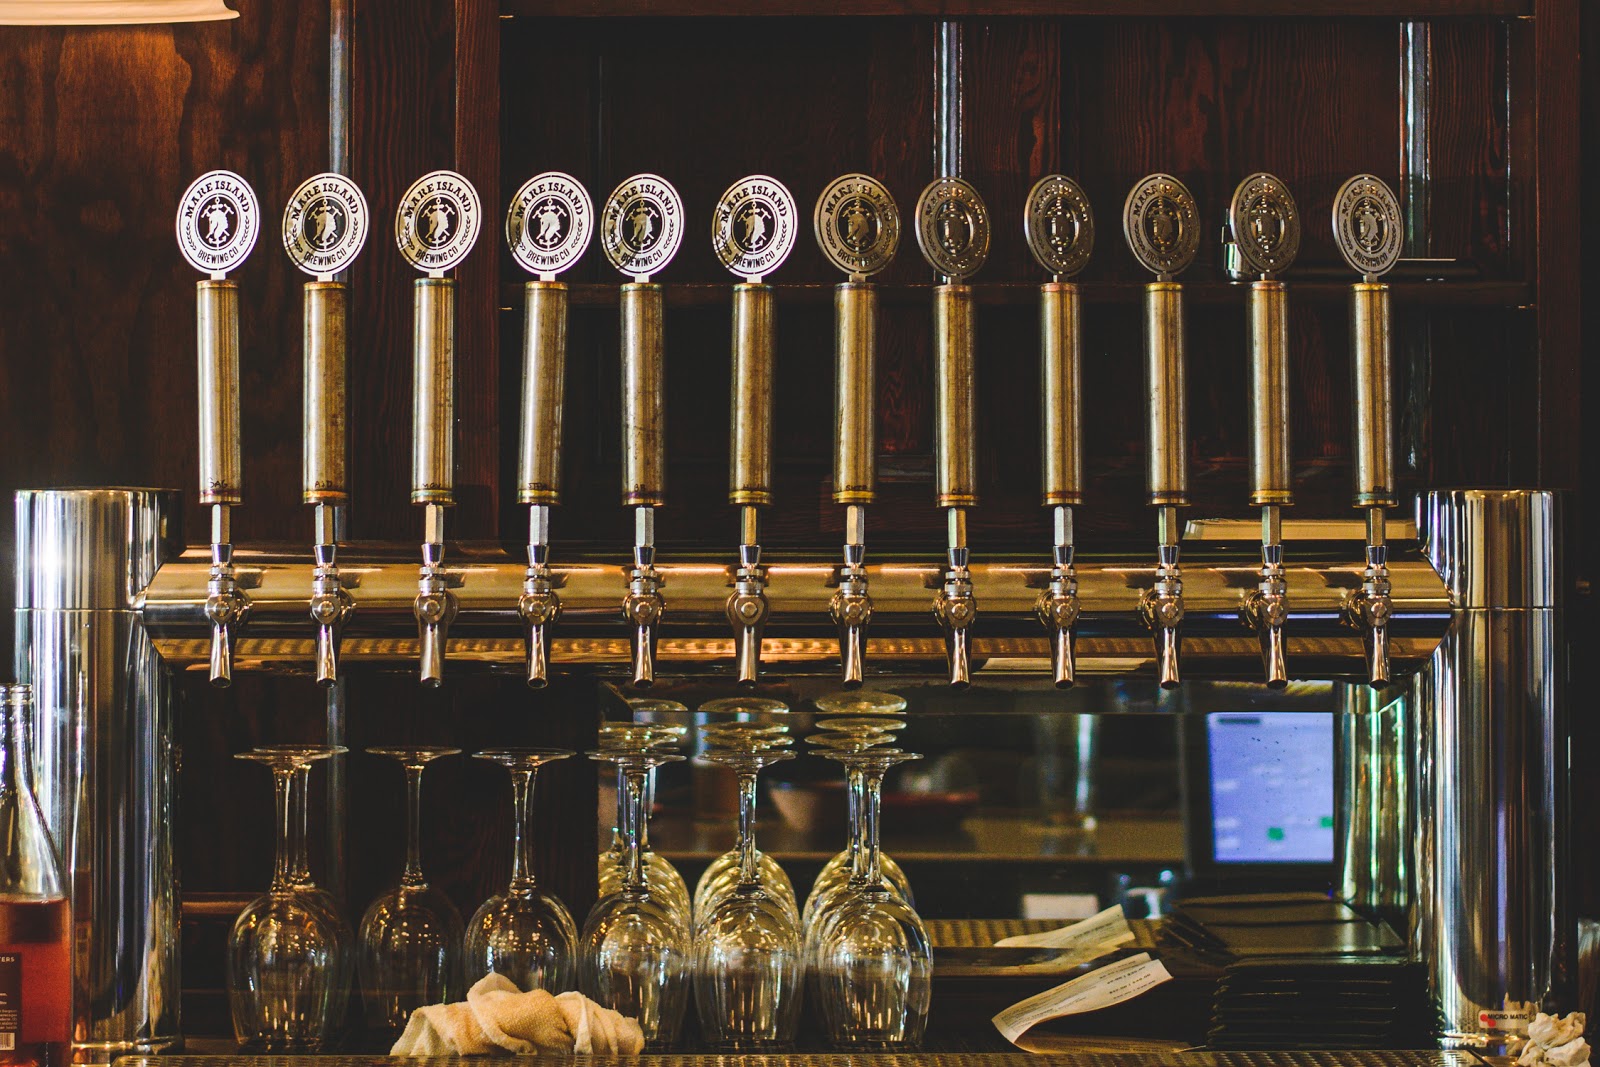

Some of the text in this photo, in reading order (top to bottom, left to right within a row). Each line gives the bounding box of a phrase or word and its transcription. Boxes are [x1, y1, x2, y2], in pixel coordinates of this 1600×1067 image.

[187, 180, 250, 218] MARE ISLAND
[293, 182, 358, 220] MARE ISLAND
[404, 182, 471, 218] MARE ISLAND
[516, 182, 584, 221] MARE ISLAND
[610, 184, 674, 221] MARE ISLAND
[722, 185, 787, 223] MARE ISLAND
[825, 184, 854, 216] MARE
[197, 248, 229, 264] BREWING
[304, 251, 336, 266] BREWING
[415, 248, 448, 264] BREWING
[526, 251, 560, 266] BREWING
[620, 252, 652, 268] BREWING
[732, 254, 765, 268] BREWING
